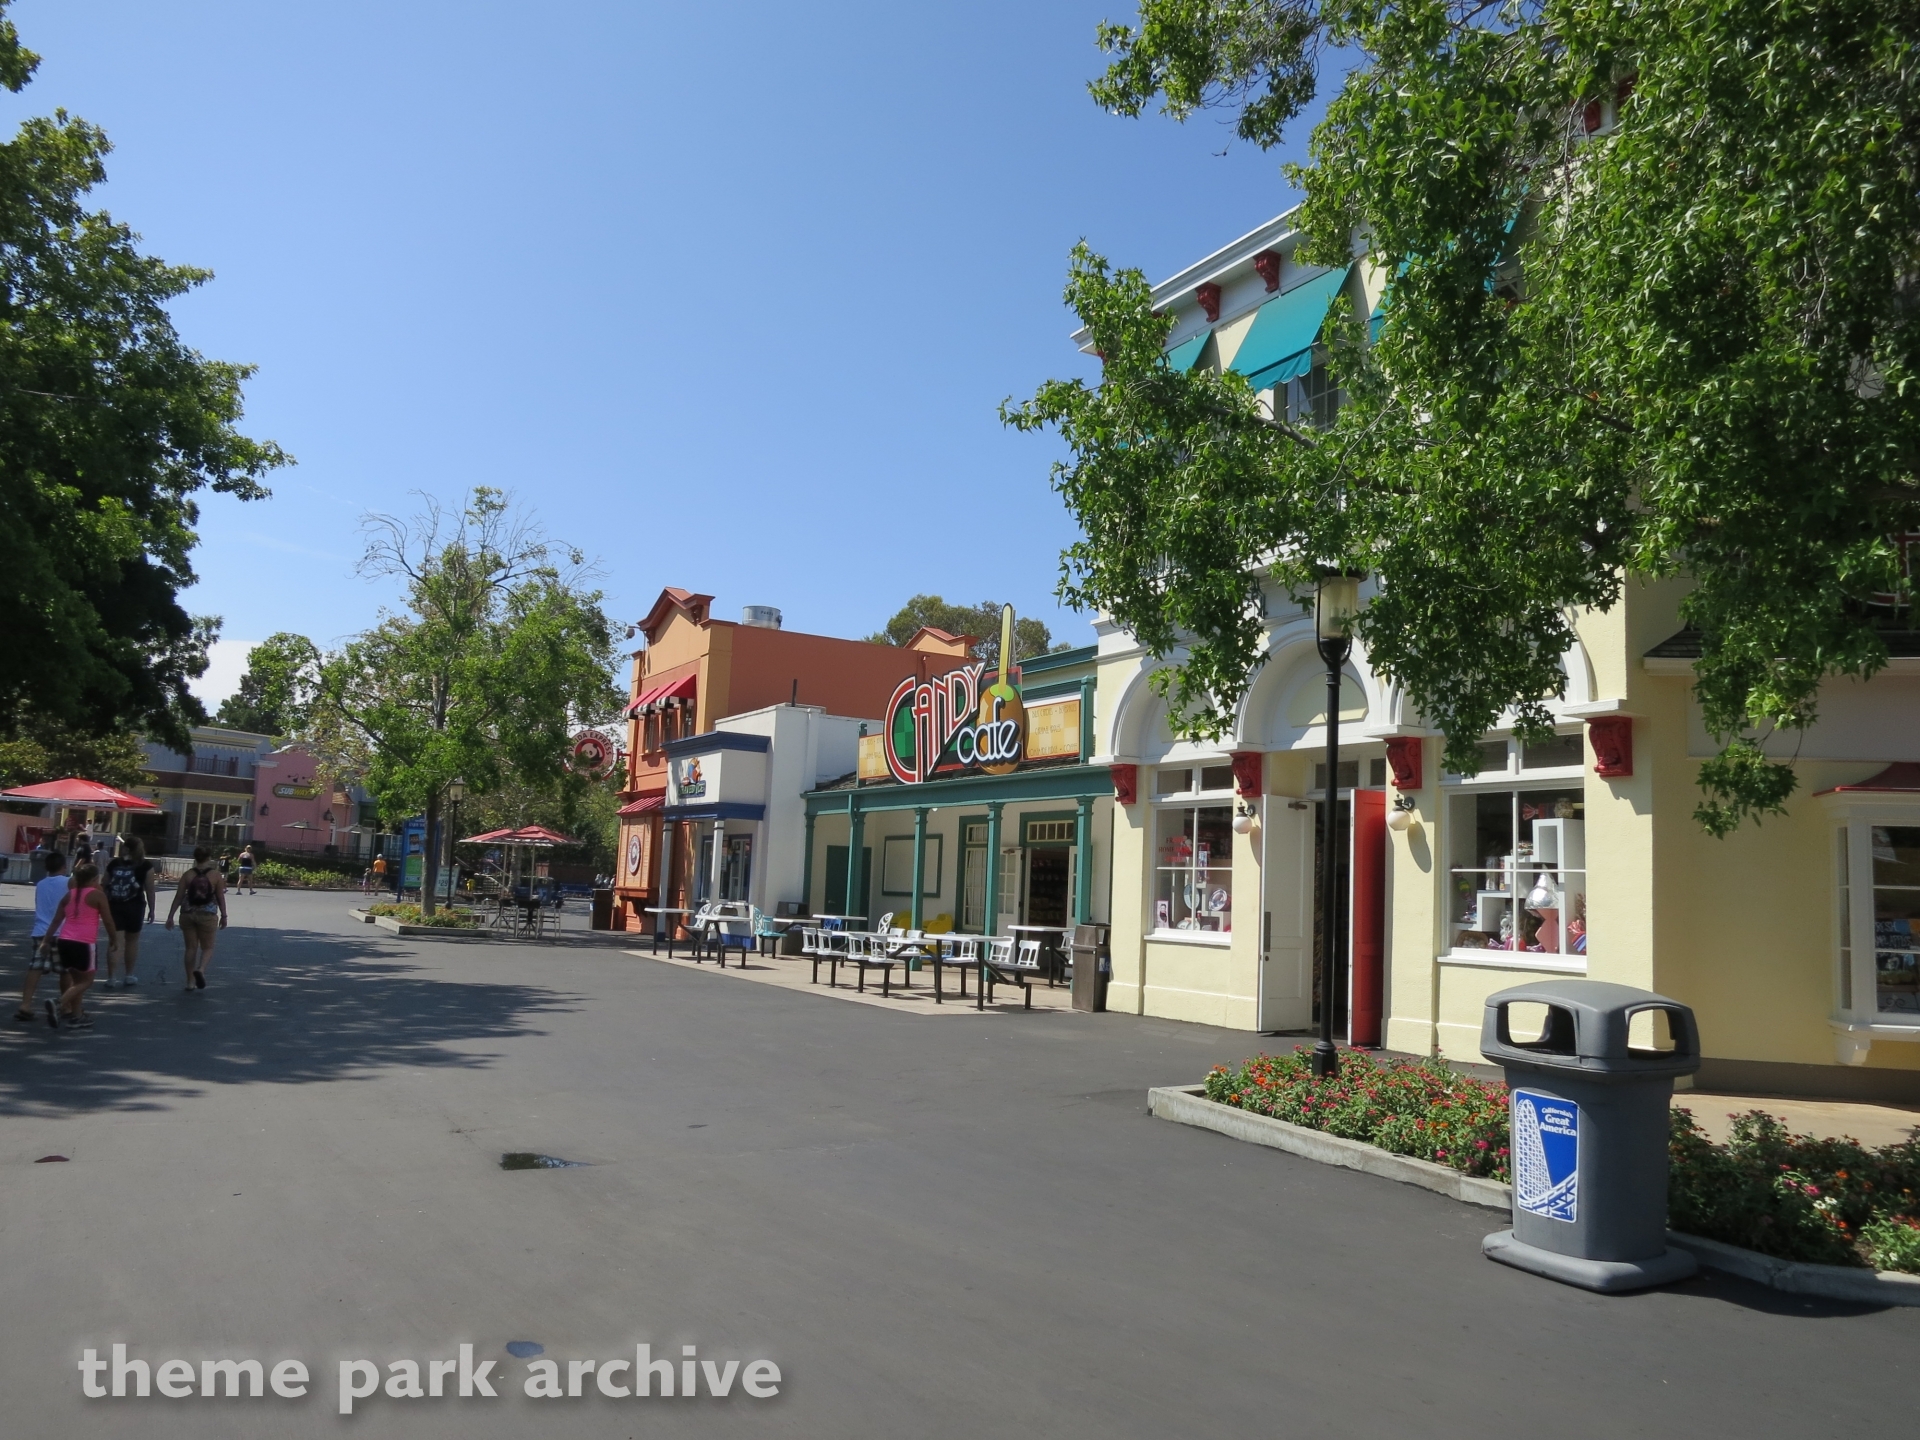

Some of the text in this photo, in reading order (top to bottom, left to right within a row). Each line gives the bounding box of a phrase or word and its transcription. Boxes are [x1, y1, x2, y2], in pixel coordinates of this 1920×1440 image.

[884, 662, 985, 783] CANDY
[957, 697, 1019, 764] cafe
[569, 731, 612, 756] PADA EXPRESS
[278, 787, 311, 797] SUBWAY
[1540, 1122, 1577, 1136] America
[1545, 1114, 1570, 1126] Great
